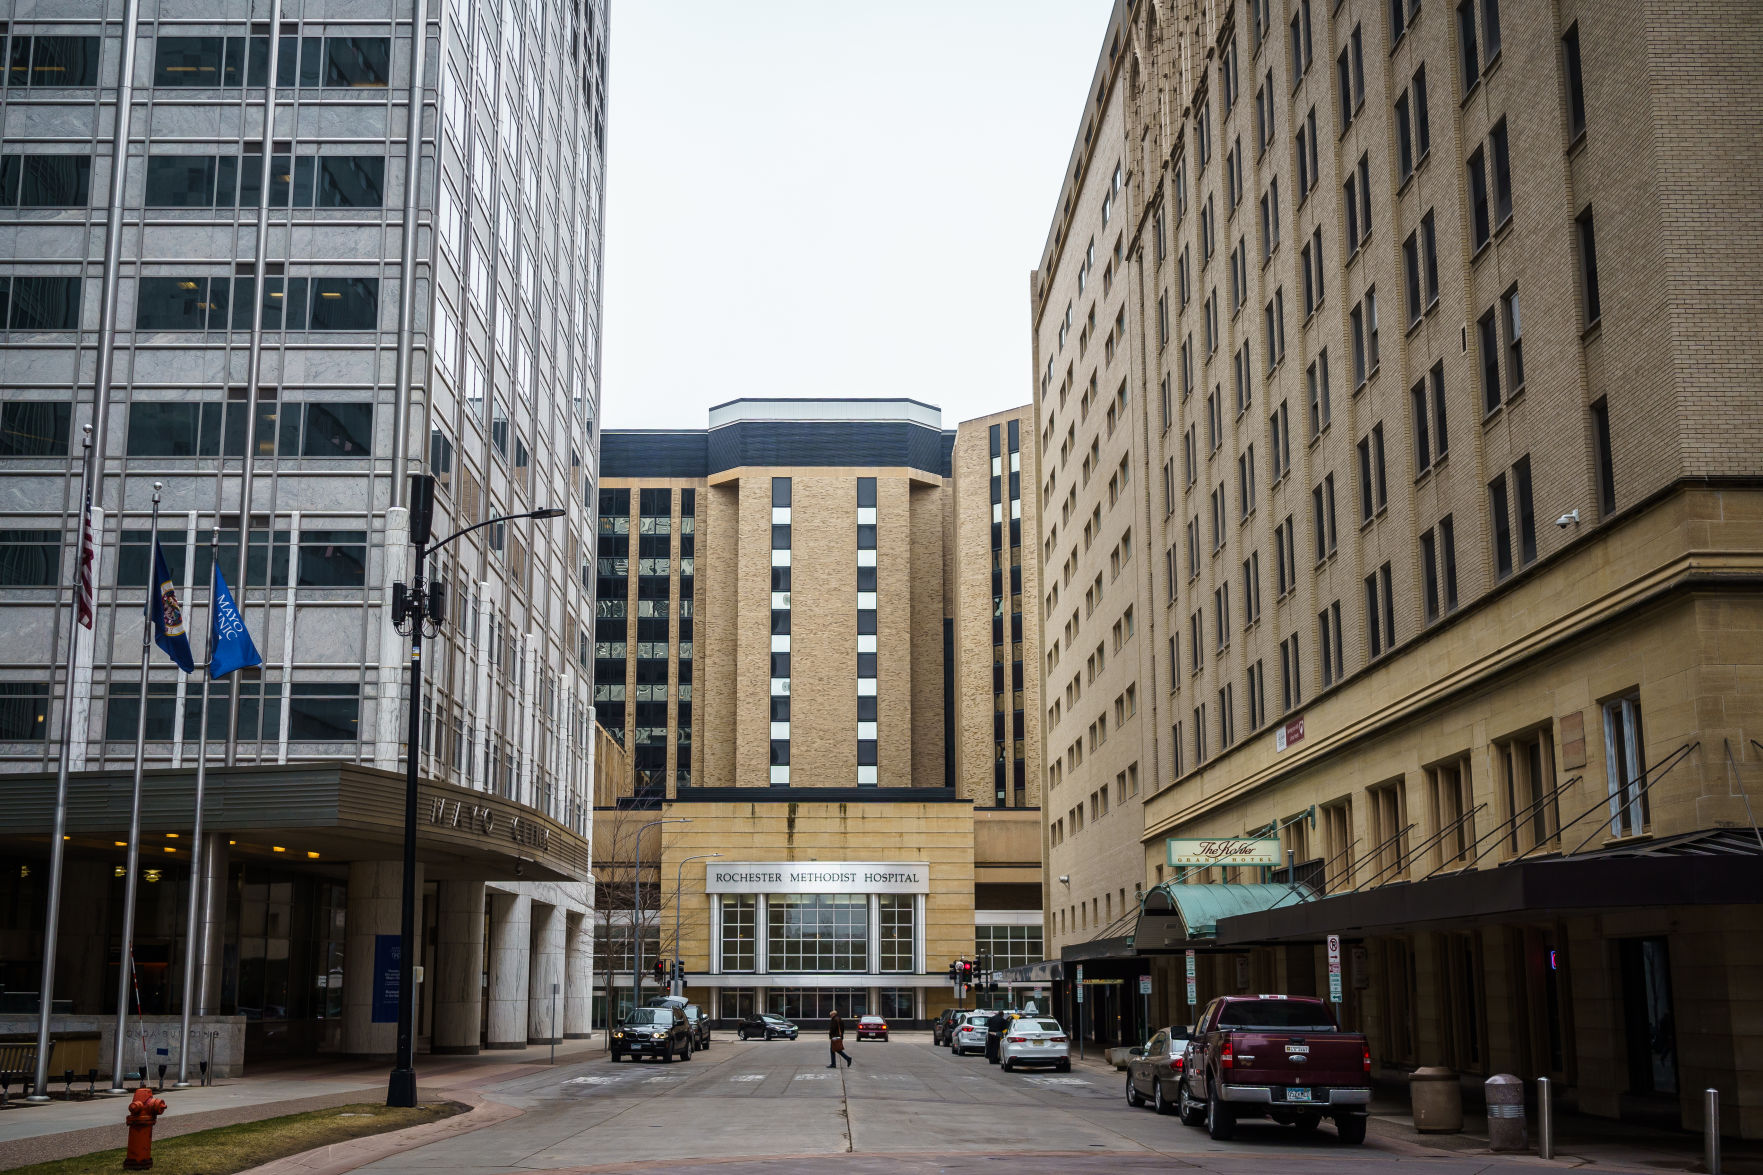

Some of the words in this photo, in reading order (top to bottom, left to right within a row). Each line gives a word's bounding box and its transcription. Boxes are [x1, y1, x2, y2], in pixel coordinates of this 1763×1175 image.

[217, 594, 243, 632] MAYO
[218, 612, 237, 640] NIC
[430, 797, 494, 833] MAYO
[1193, 841, 1219, 856] The
[716, 872, 782, 882] ROCHESTER
[790, 872, 857, 882] METHODIST
[864, 873, 919, 883] HOSPITAL
[126, 1030, 157, 1038] ONDA
[162, 1030, 219, 1038] BUIDING
